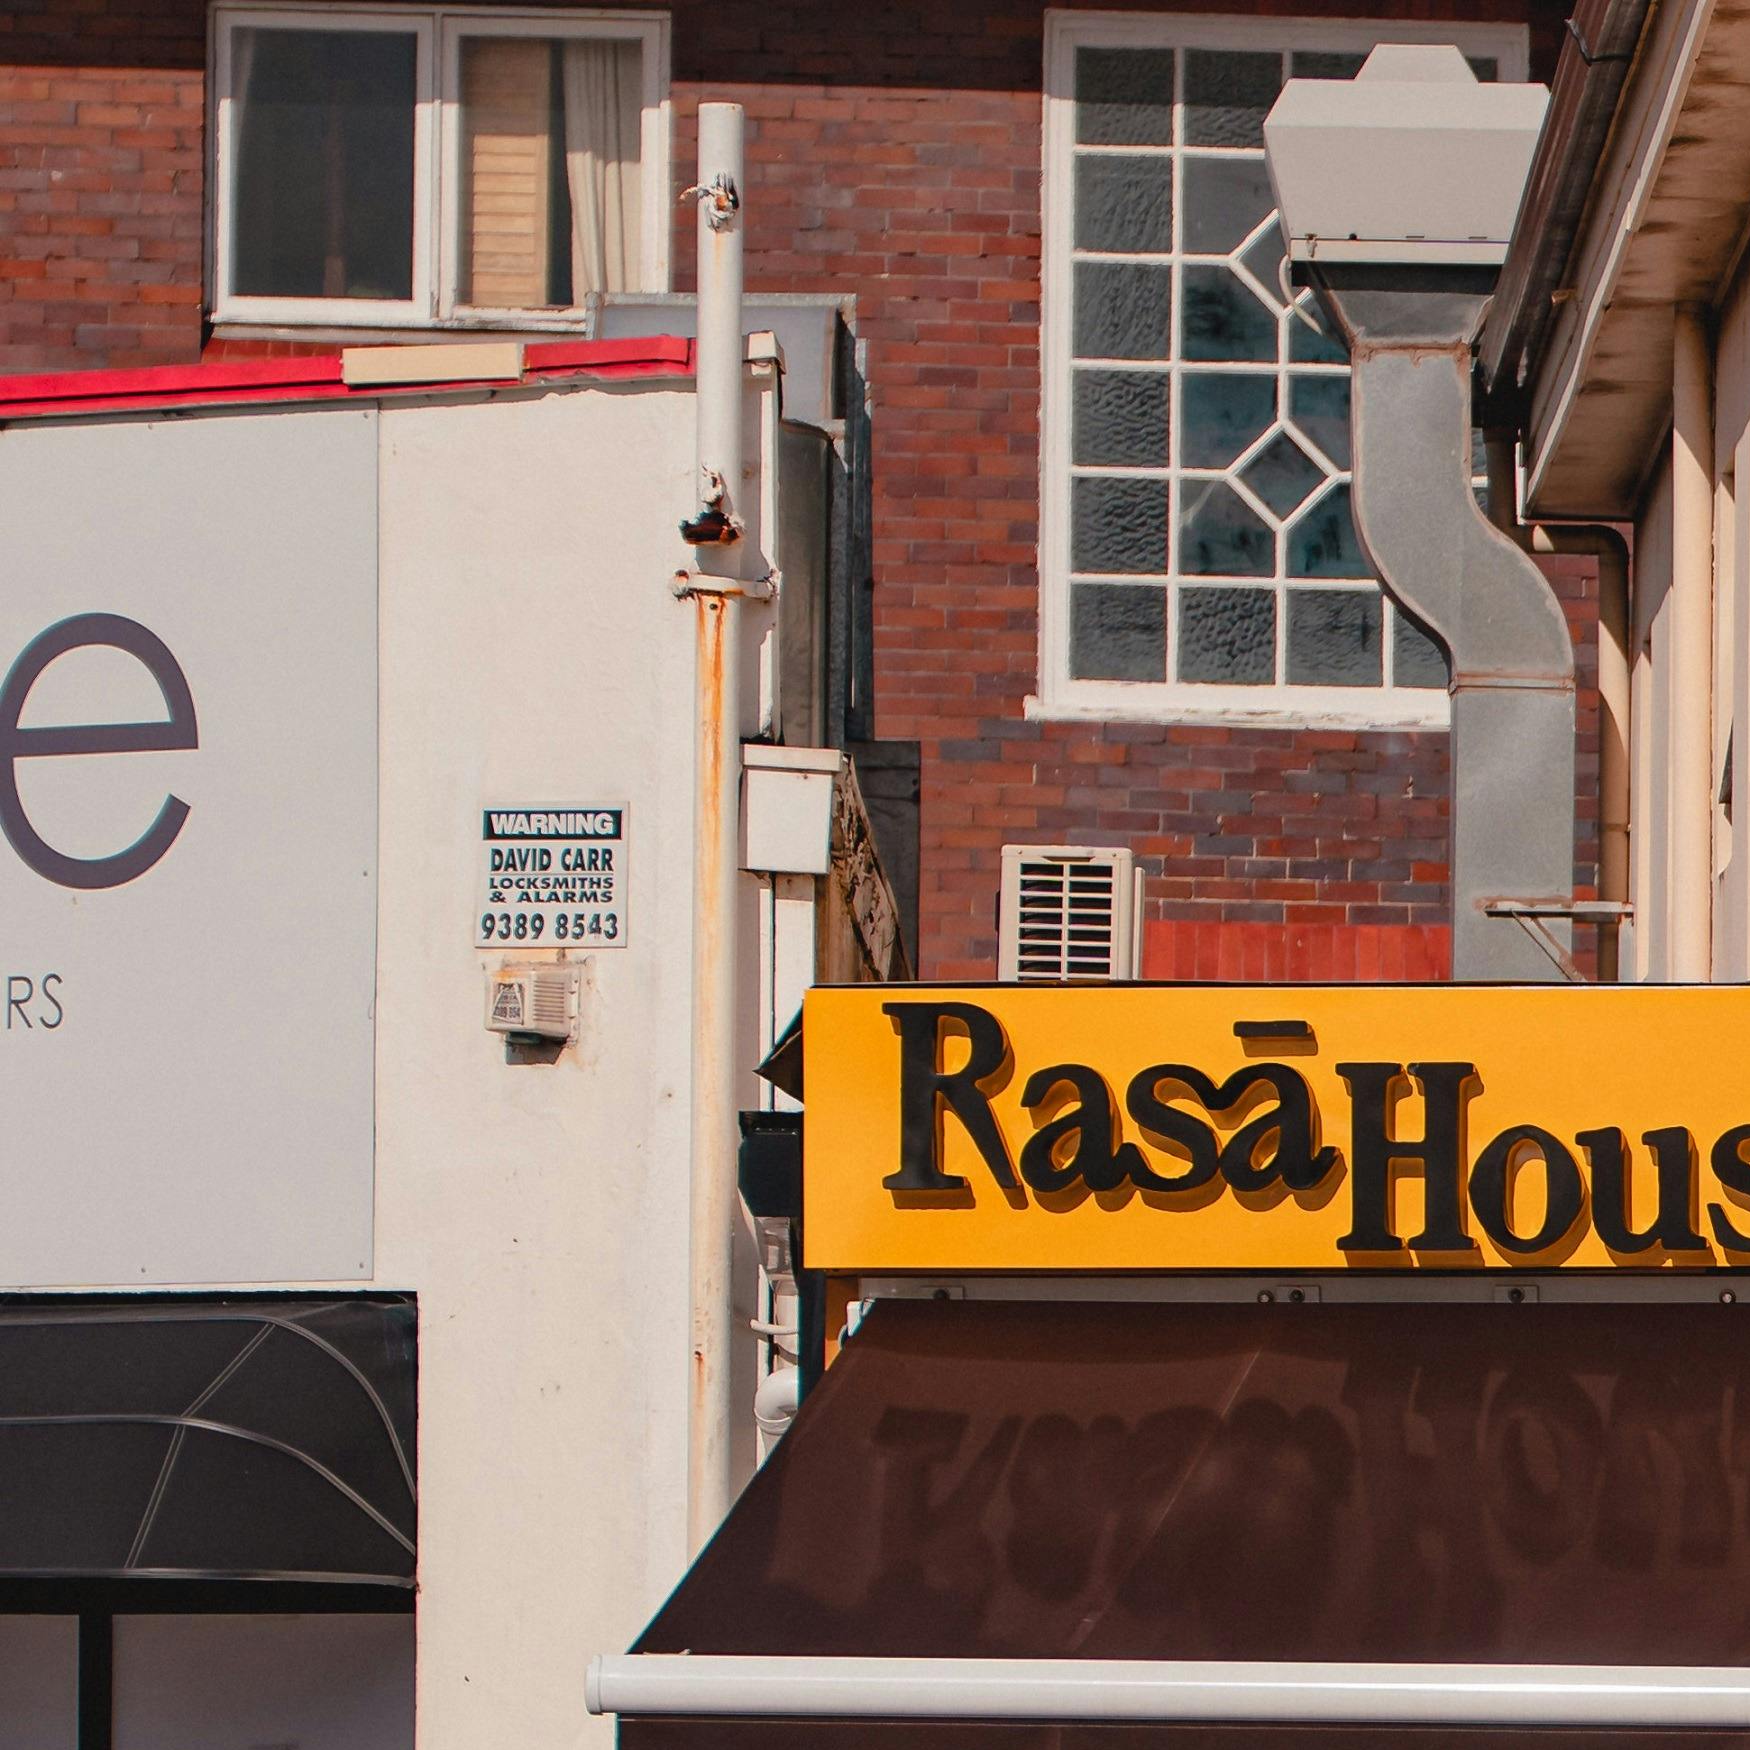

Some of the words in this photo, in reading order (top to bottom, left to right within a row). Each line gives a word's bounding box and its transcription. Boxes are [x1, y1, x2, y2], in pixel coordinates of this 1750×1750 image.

[490, 812, 614, 835] WARNING
[490, 847, 552, 872] DAVID
[560, 847, 614, 872] CARR
[489, 877, 614, 890] LOCKSMITHS
[489, 890, 507, 903] &
[516, 890, 613, 903] ALARMS
[481, 912, 545, 940] 9389
[554, 912, 618, 940] 8543
[7, 973, 63, 1030] RS
